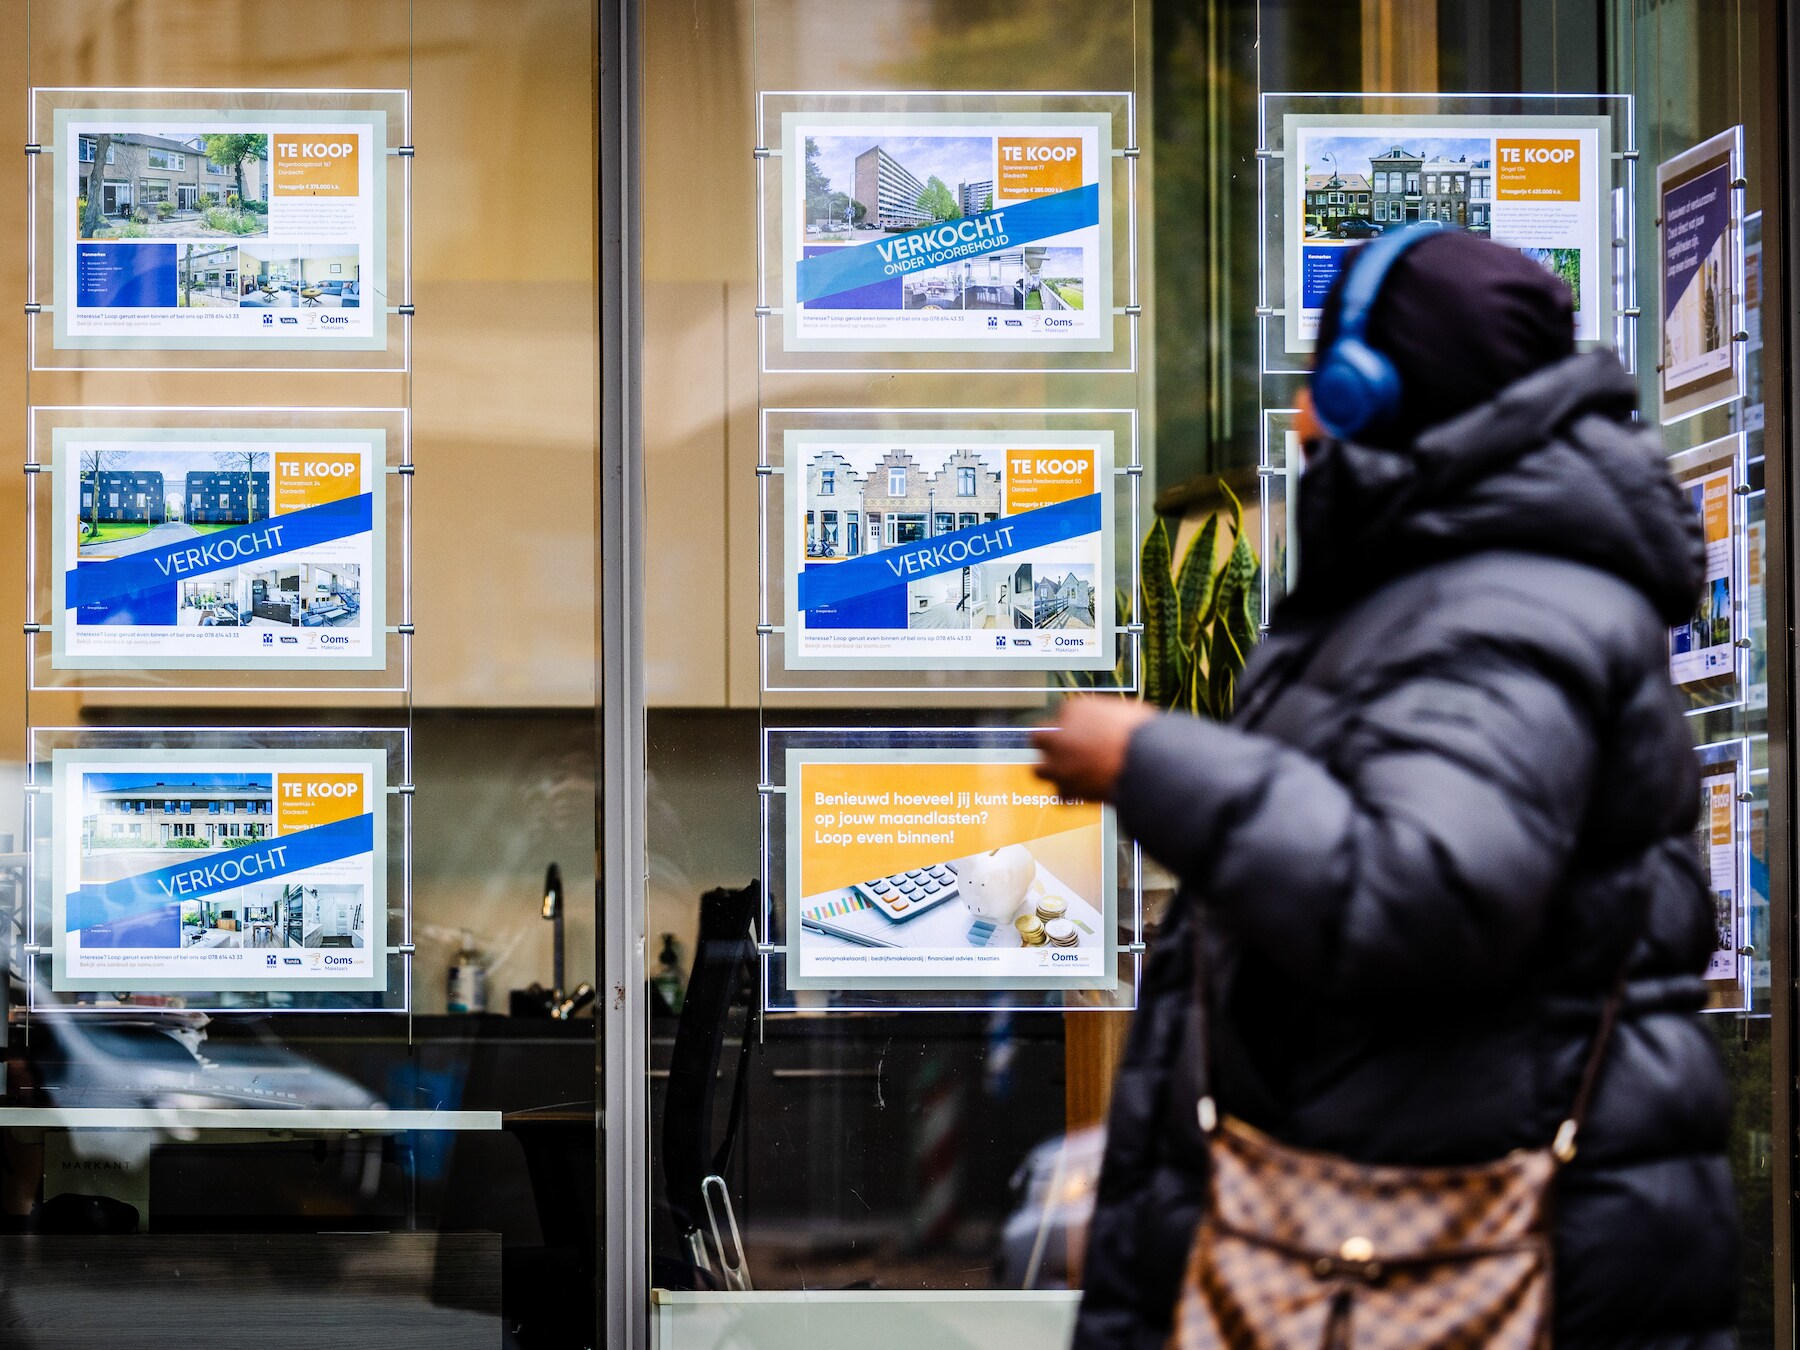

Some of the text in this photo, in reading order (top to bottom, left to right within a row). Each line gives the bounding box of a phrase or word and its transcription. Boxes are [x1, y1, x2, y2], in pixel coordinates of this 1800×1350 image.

[278, 143, 353, 158] TE KOOP
[1002, 146, 1077, 161] TE KOOP
[1500, 148, 1575, 163] TE KOOP
[876, 212, 1006, 263] VERKOCHT
[884, 234, 1010, 276] ONDER VOORBEHOUD
[280, 462, 355, 477] TE KOOP
[1011, 459, 1088, 474] TE KOOP
[154, 525, 284, 577] VERKOCHT
[886, 526, 1014, 578] VERKOCHT
[282, 782, 358, 798] TE KOOP
[814, 792, 889, 806] Benieuwd
[894, 792, 953, 806] hoeveel
[957, 792, 971, 809] jij
[975, 792, 1007, 806] kunt
[814, 811, 988, 828] op jouw maandlasten?
[814, 830, 954, 847] Loop even binnen!
[158, 846, 287, 898] VERKOCHT
[62, 1161, 130, 1170] MARKANT
